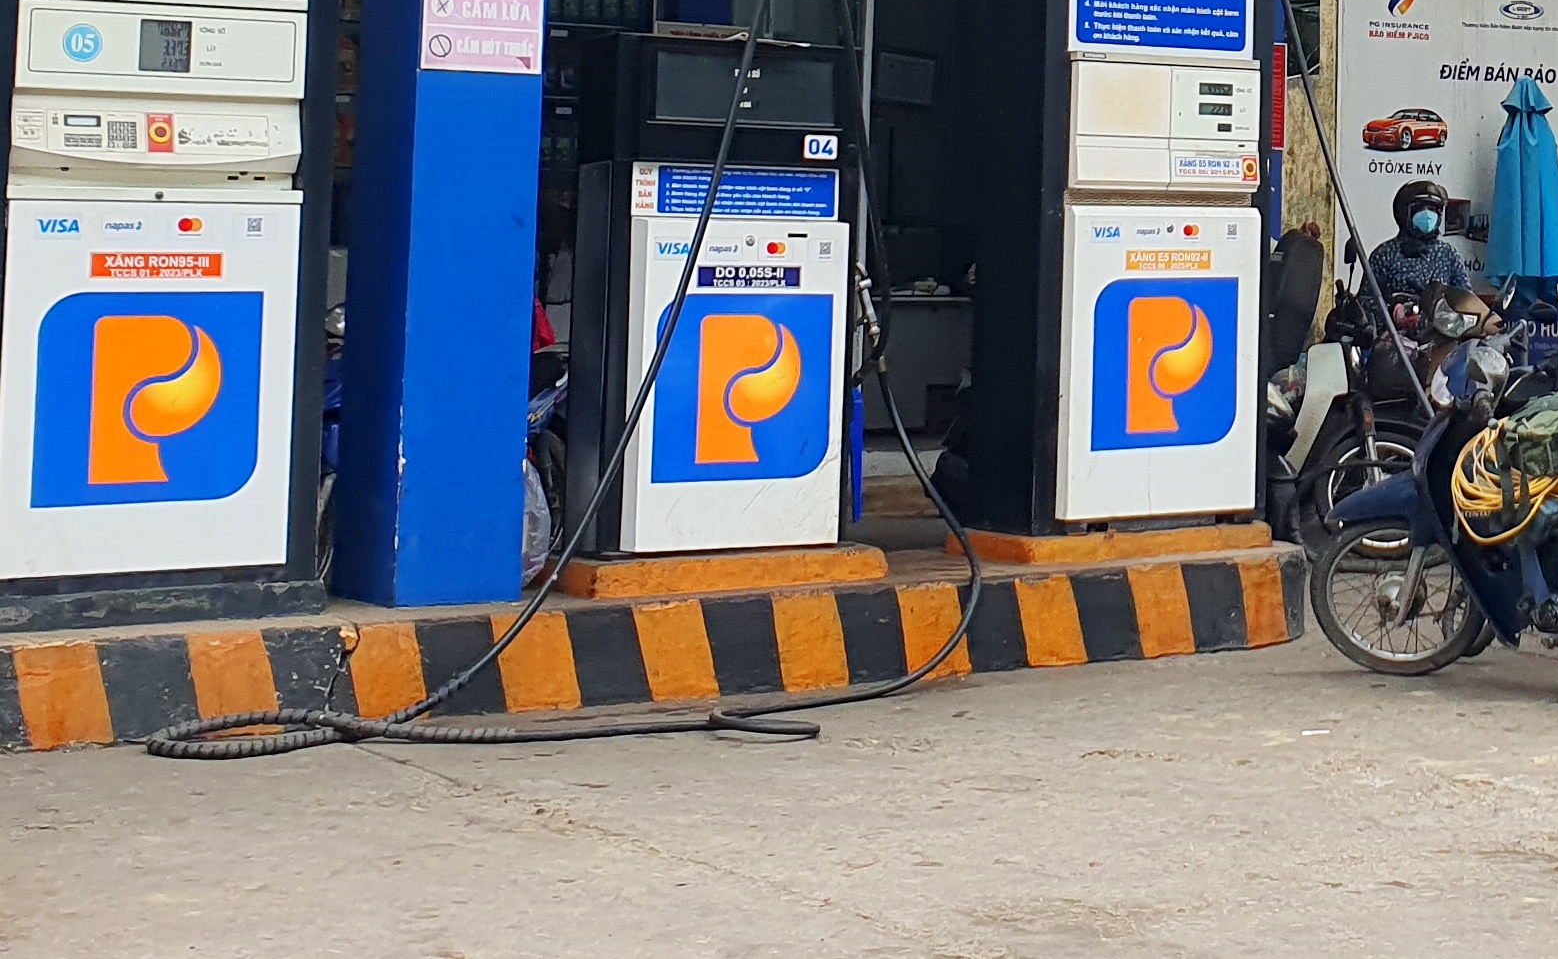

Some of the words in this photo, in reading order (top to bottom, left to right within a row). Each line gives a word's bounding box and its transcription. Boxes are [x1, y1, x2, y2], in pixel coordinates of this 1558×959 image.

[501, 0, 531, 22] LỬA
[70, 32, 95, 54] 05
[1439, 57, 1481, 81] ĐIỂM
[1484, 62, 1519, 83] BÁN
[808, 138, 834, 156] 04
[1368, 159, 1413, 174] ÔTÔ/XE
[1416, 160, 1443, 176] MÁY
[36, 218, 80, 234] VISA
[104, 221, 135, 232] napas
[1092, 226, 1121, 238] VISA
[658, 242, 691, 255] VISA
[104, 253, 145, 268] XĂNG
[148, 255, 210, 268] RON95-III
[109, 268, 138, 278] TCCS
[715, 266, 736, 278] DO
